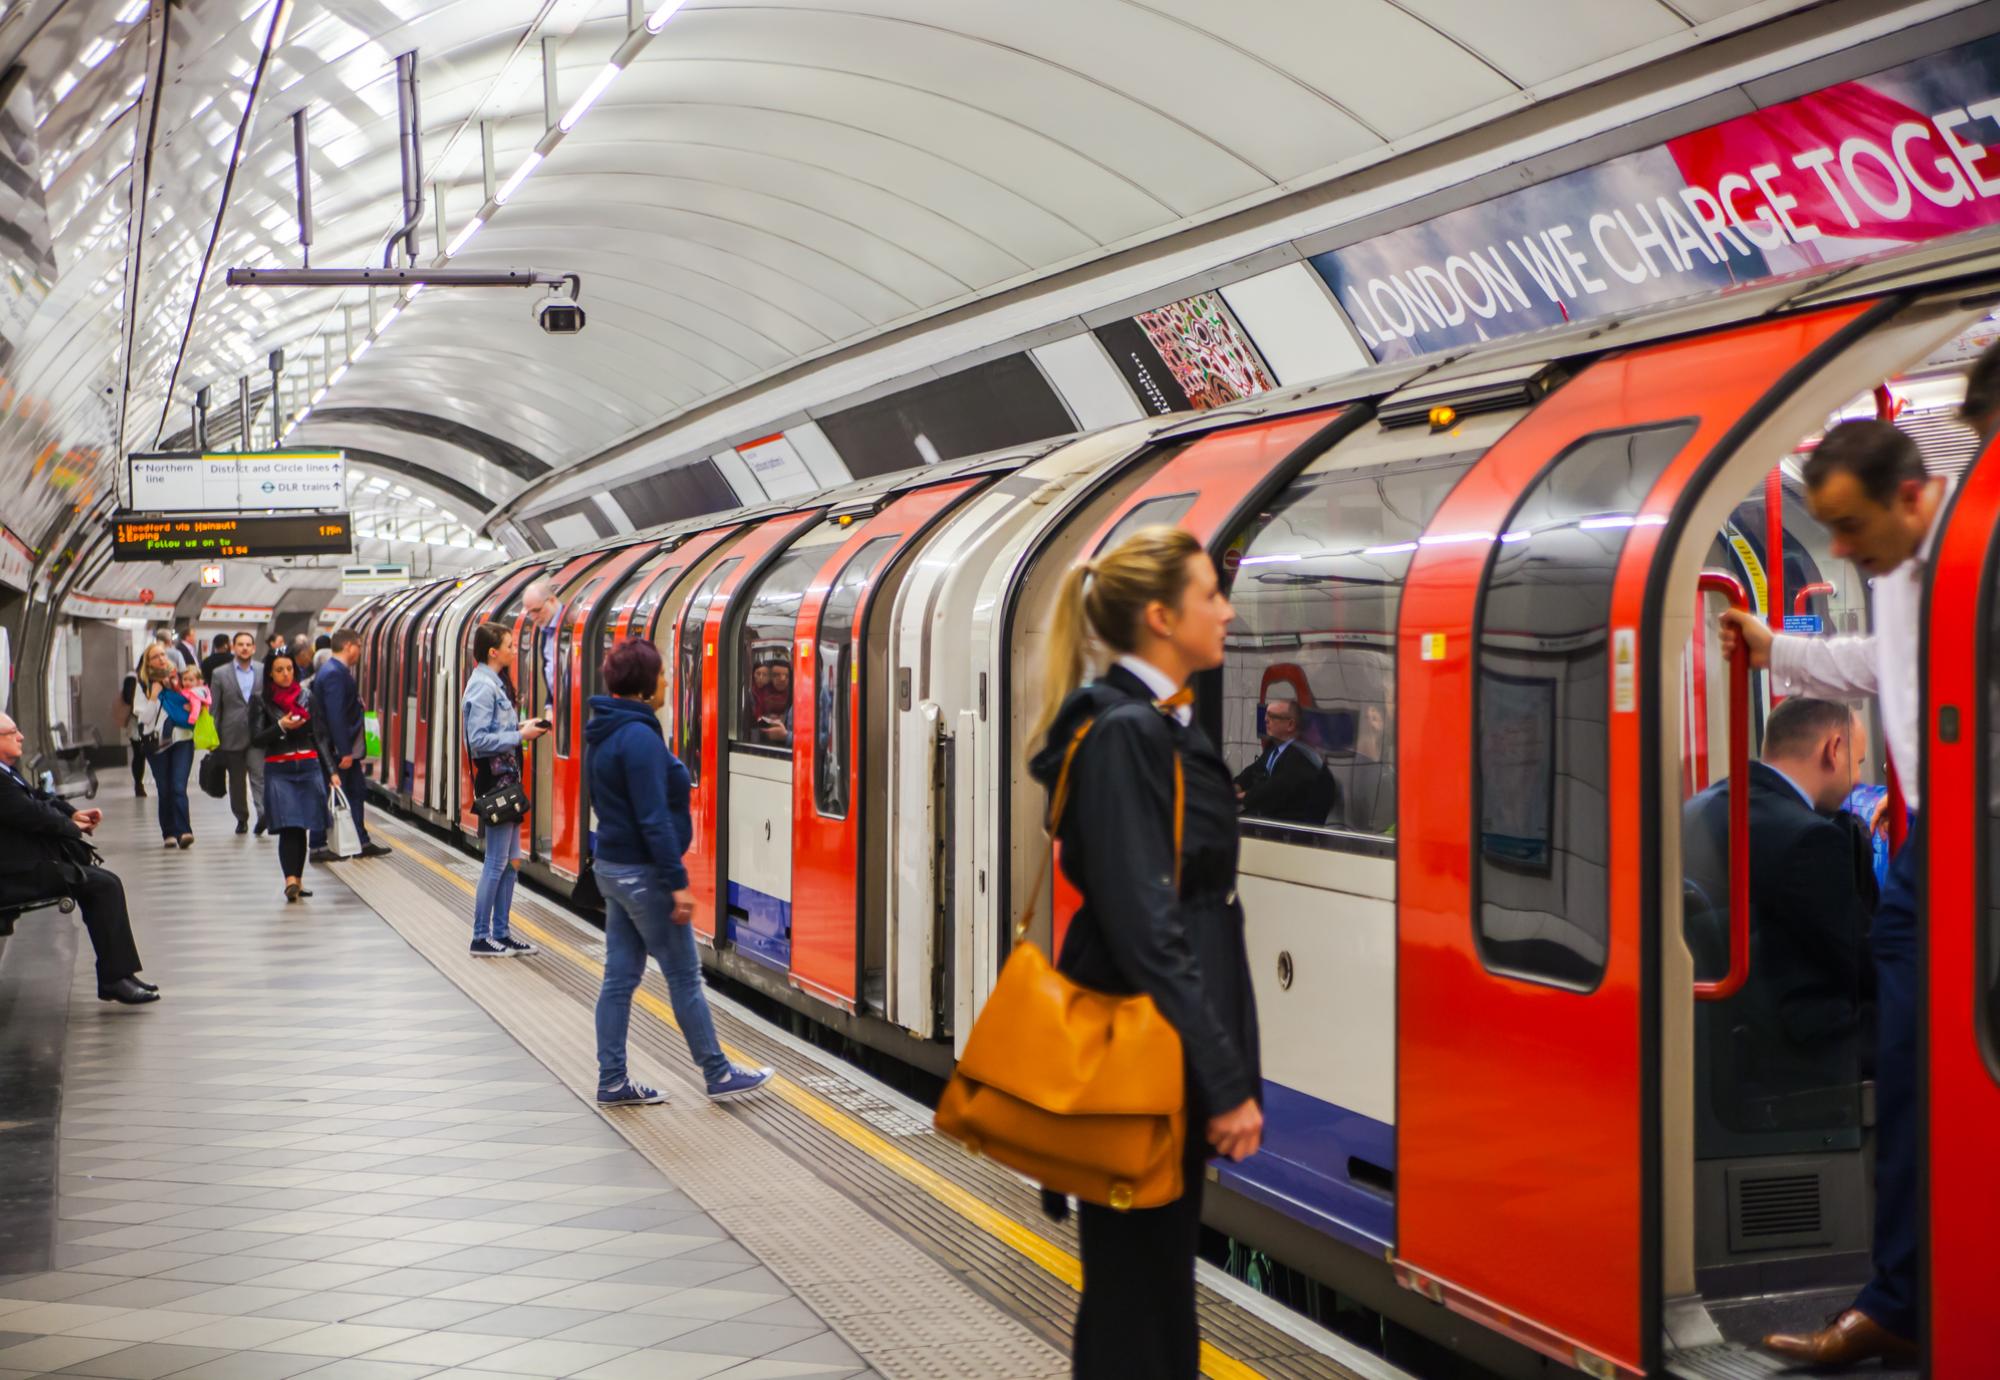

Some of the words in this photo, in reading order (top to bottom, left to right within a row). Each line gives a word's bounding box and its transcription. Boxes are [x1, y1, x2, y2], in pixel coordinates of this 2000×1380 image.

[1348, 246, 1532, 342] LONDON
[1506, 224, 1608, 303] WE
[1589, 163, 1822, 284] CHARGE
[146, 464, 193, 473] Northern
[210, 464, 248, 473] District
[252, 464, 271, 473] and
[273, 463, 303, 472] Circle
[306, 463, 330, 472] lines
[146, 475, 165, 483] line
[278, 483, 298, 491] DLR
[302, 483, 330, 491] trains
[118, 523, 123, 532] 1
[175, 522, 191, 531] via
[127, 532, 160, 542] Epping
[147, 539, 180, 550] Follow
[185, 539, 197, 548] us
[202, 539, 214, 548] on
